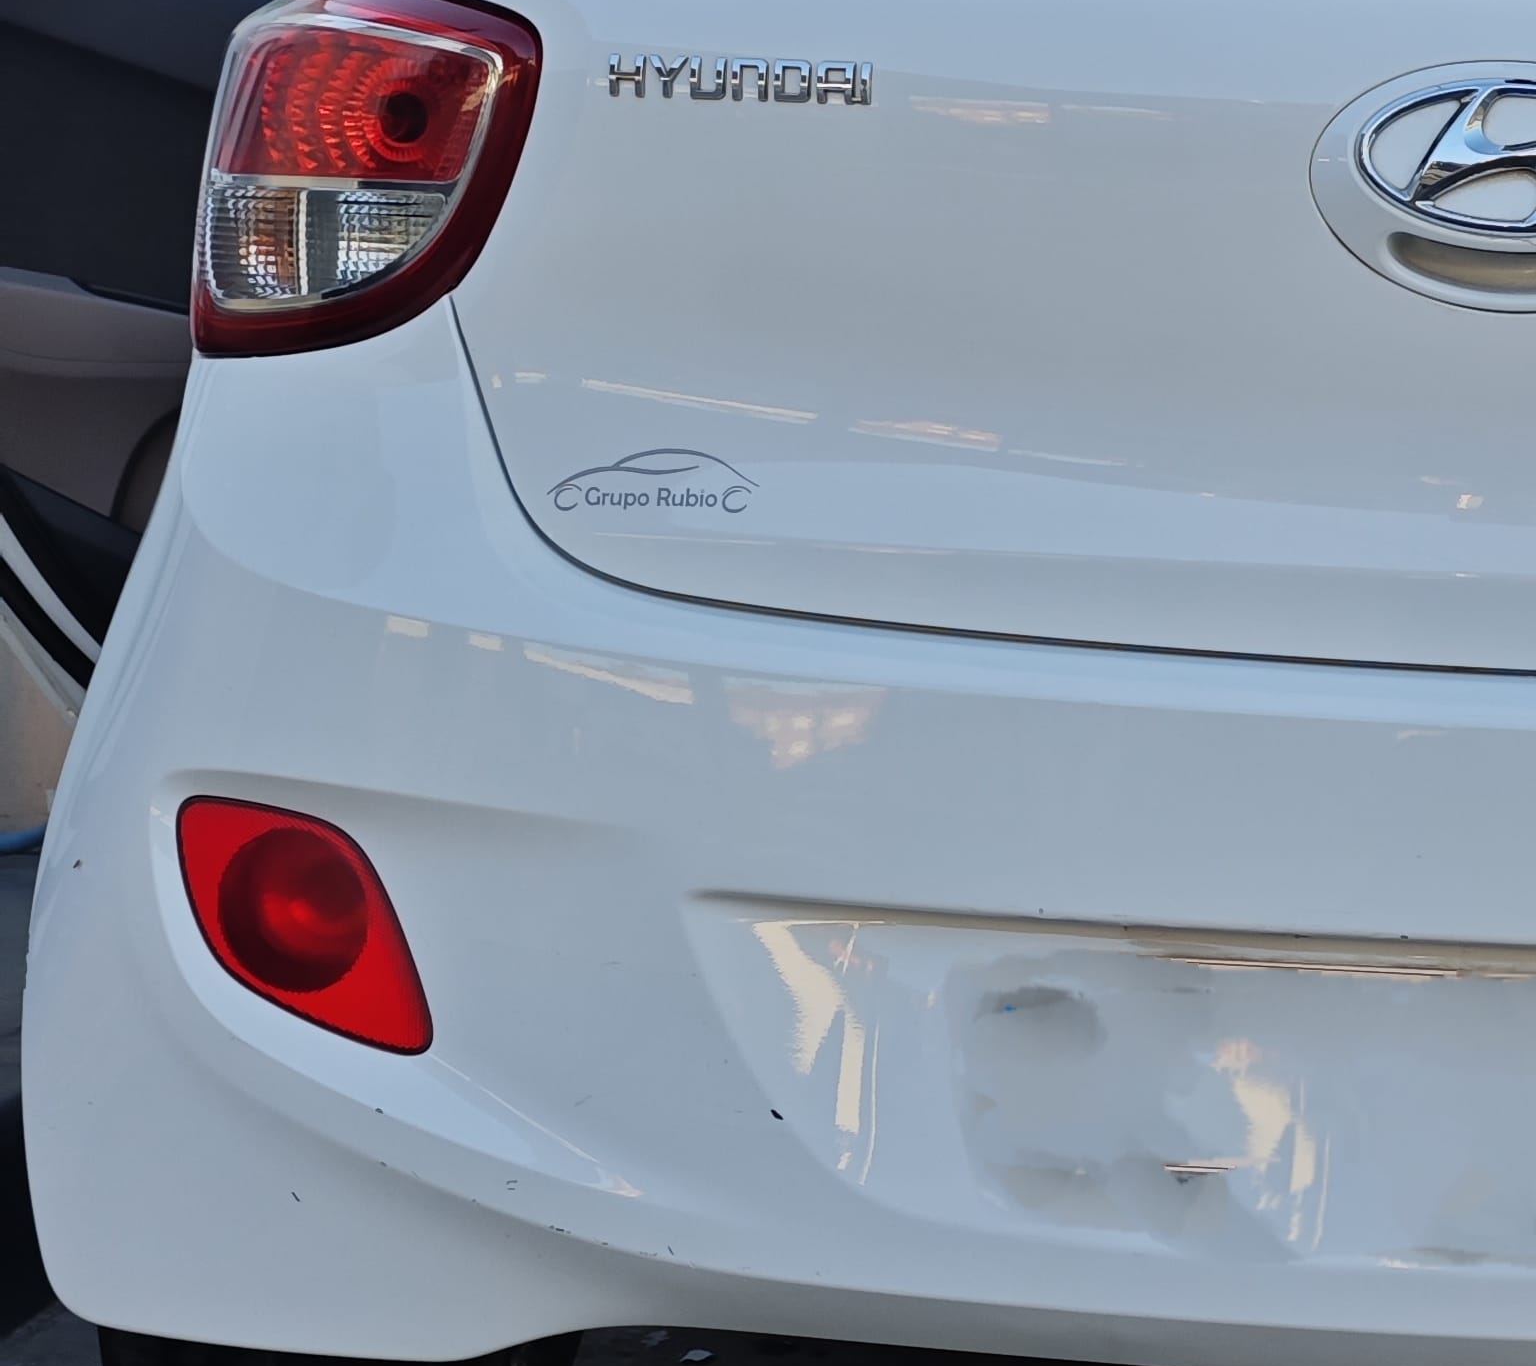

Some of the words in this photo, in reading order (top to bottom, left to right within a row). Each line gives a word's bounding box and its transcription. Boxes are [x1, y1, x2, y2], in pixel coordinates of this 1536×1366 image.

[608, 52, 874, 106] HYUNDAI
[584, 486, 650, 511] Grupo
[656, 487, 719, 508] Rubio
